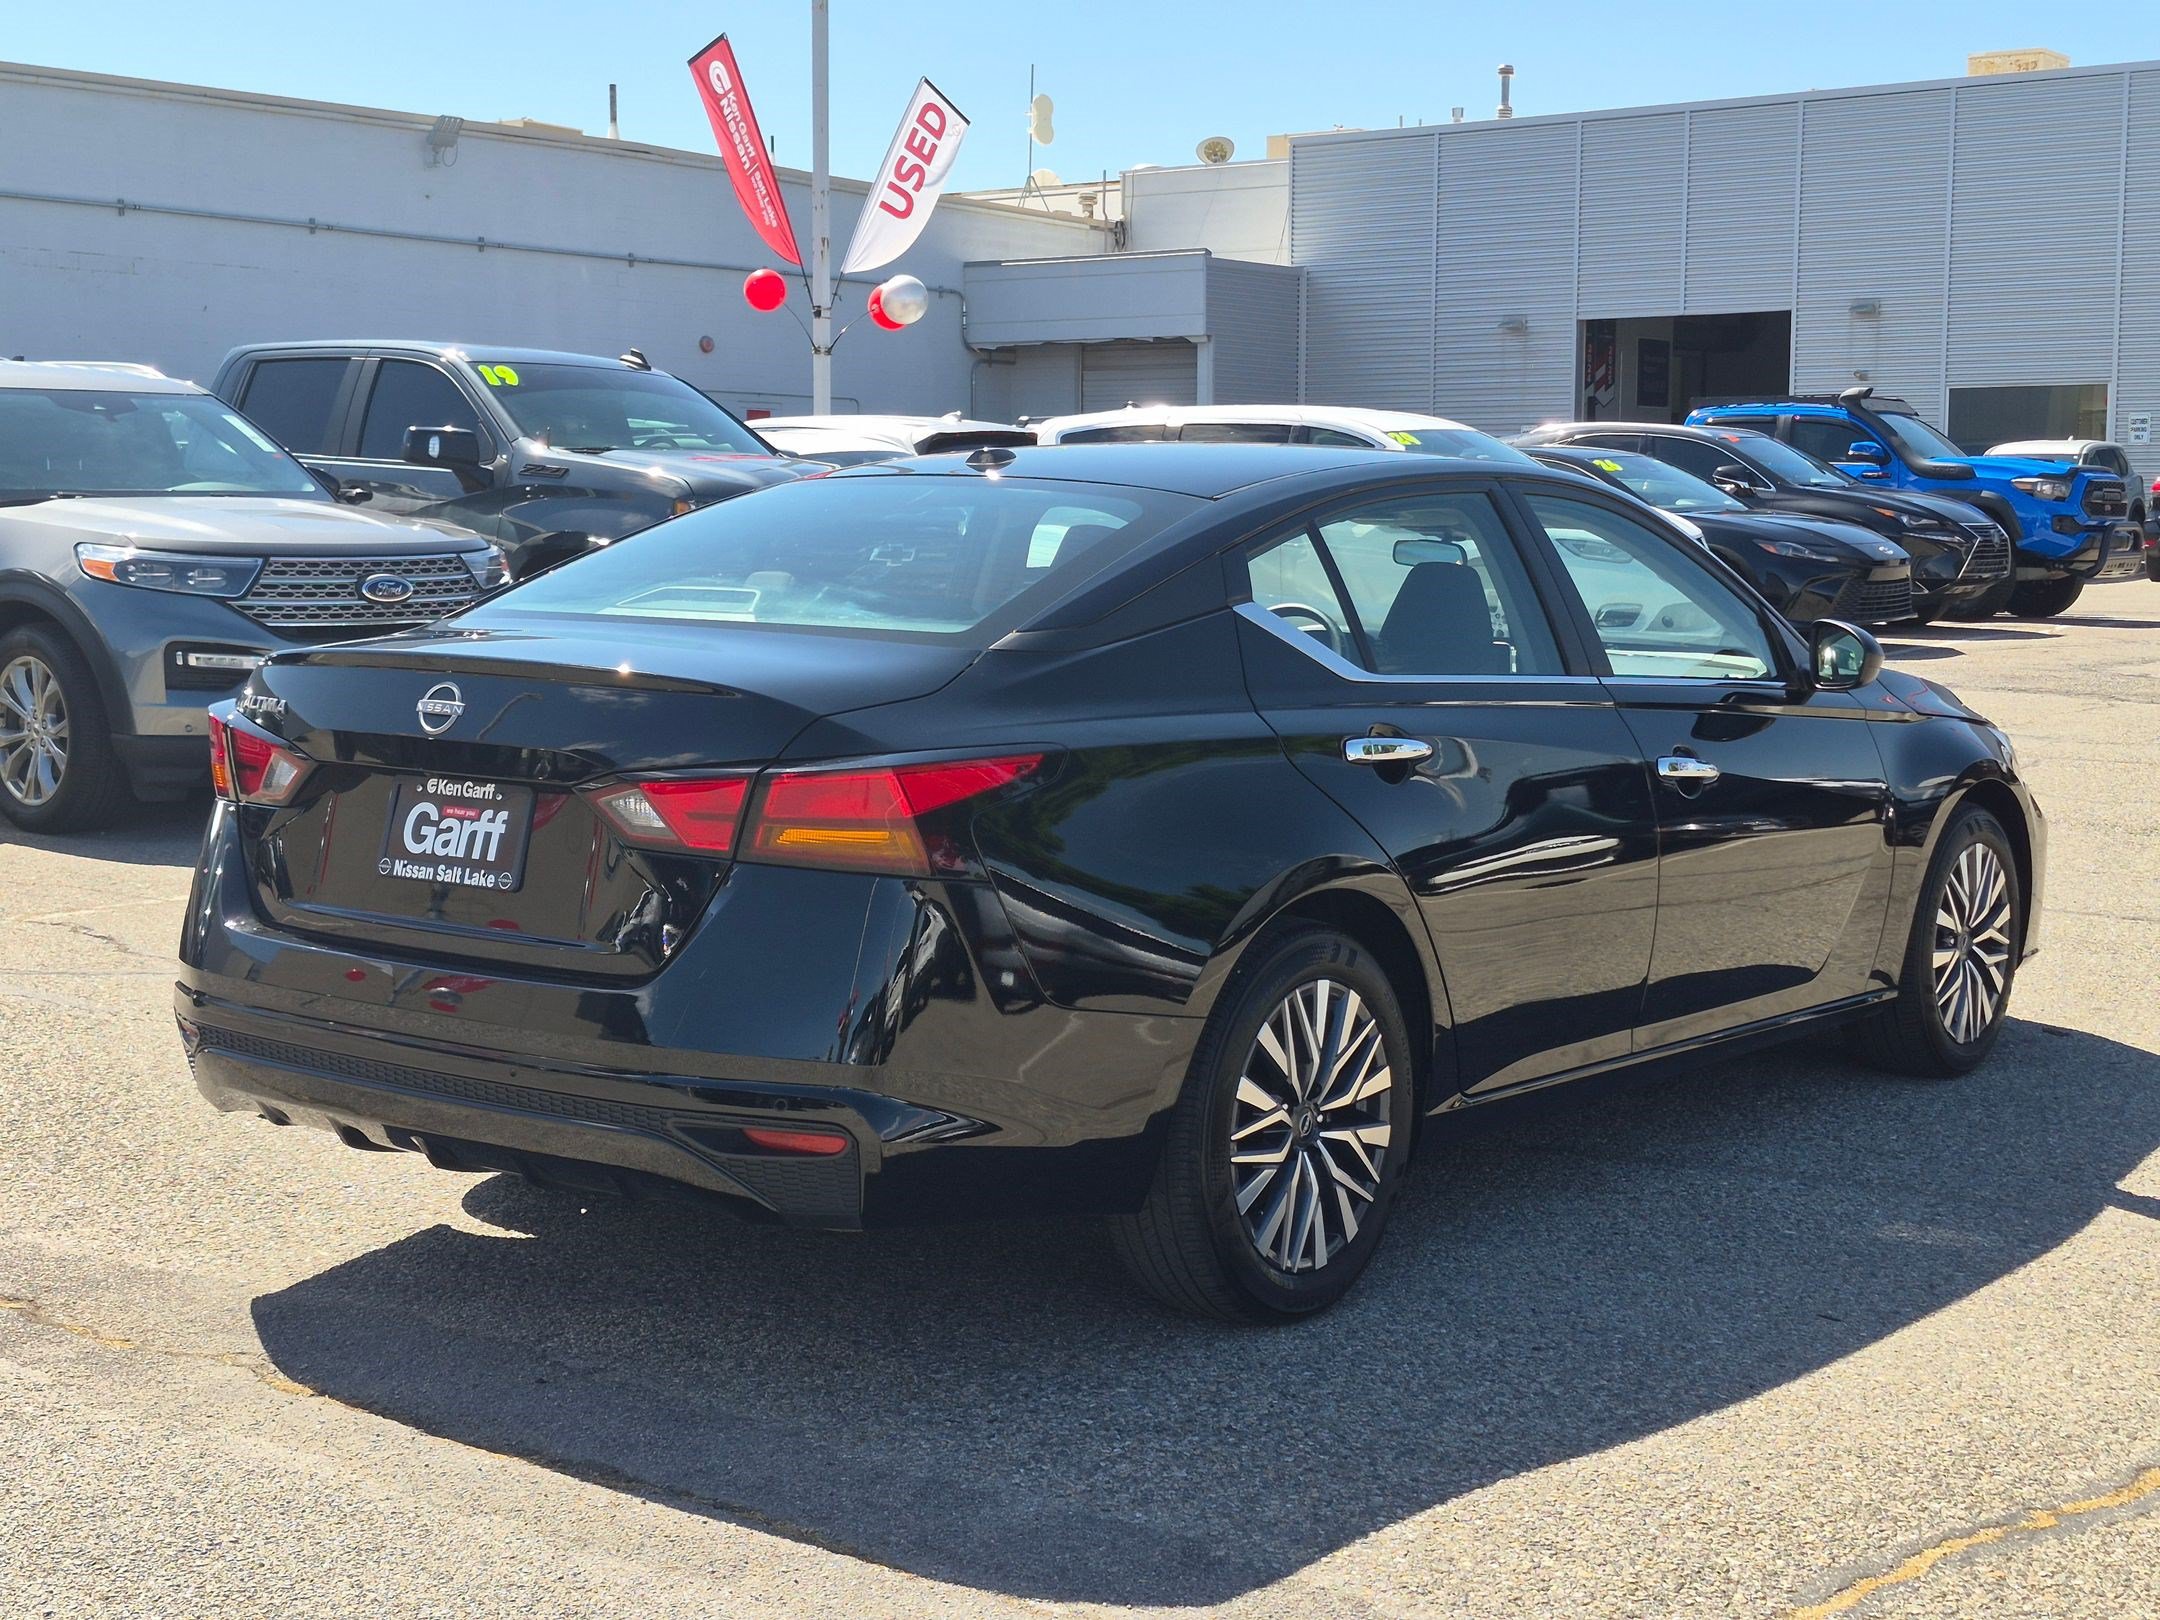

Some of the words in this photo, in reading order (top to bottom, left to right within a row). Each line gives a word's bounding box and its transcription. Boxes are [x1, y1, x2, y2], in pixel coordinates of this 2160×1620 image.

[727, 91, 741, 122] Ken
[719, 97, 751, 171] Nissan
[878, 101, 947, 220] USED
[477, 364, 519, 386] 19
[376, 581, 402, 596] Ford
[243, 695, 287, 714] ALTIMA
[416, 702, 463, 715] NISSAN
[437, 779, 462, 797] Ken
[463, 781, 496, 800] Garff
[403, 801, 509, 862] Garff
[393, 859, 434, 880] Nissan
[436, 864, 462, 884] Salt
[463, 867, 495, 888] Lake
